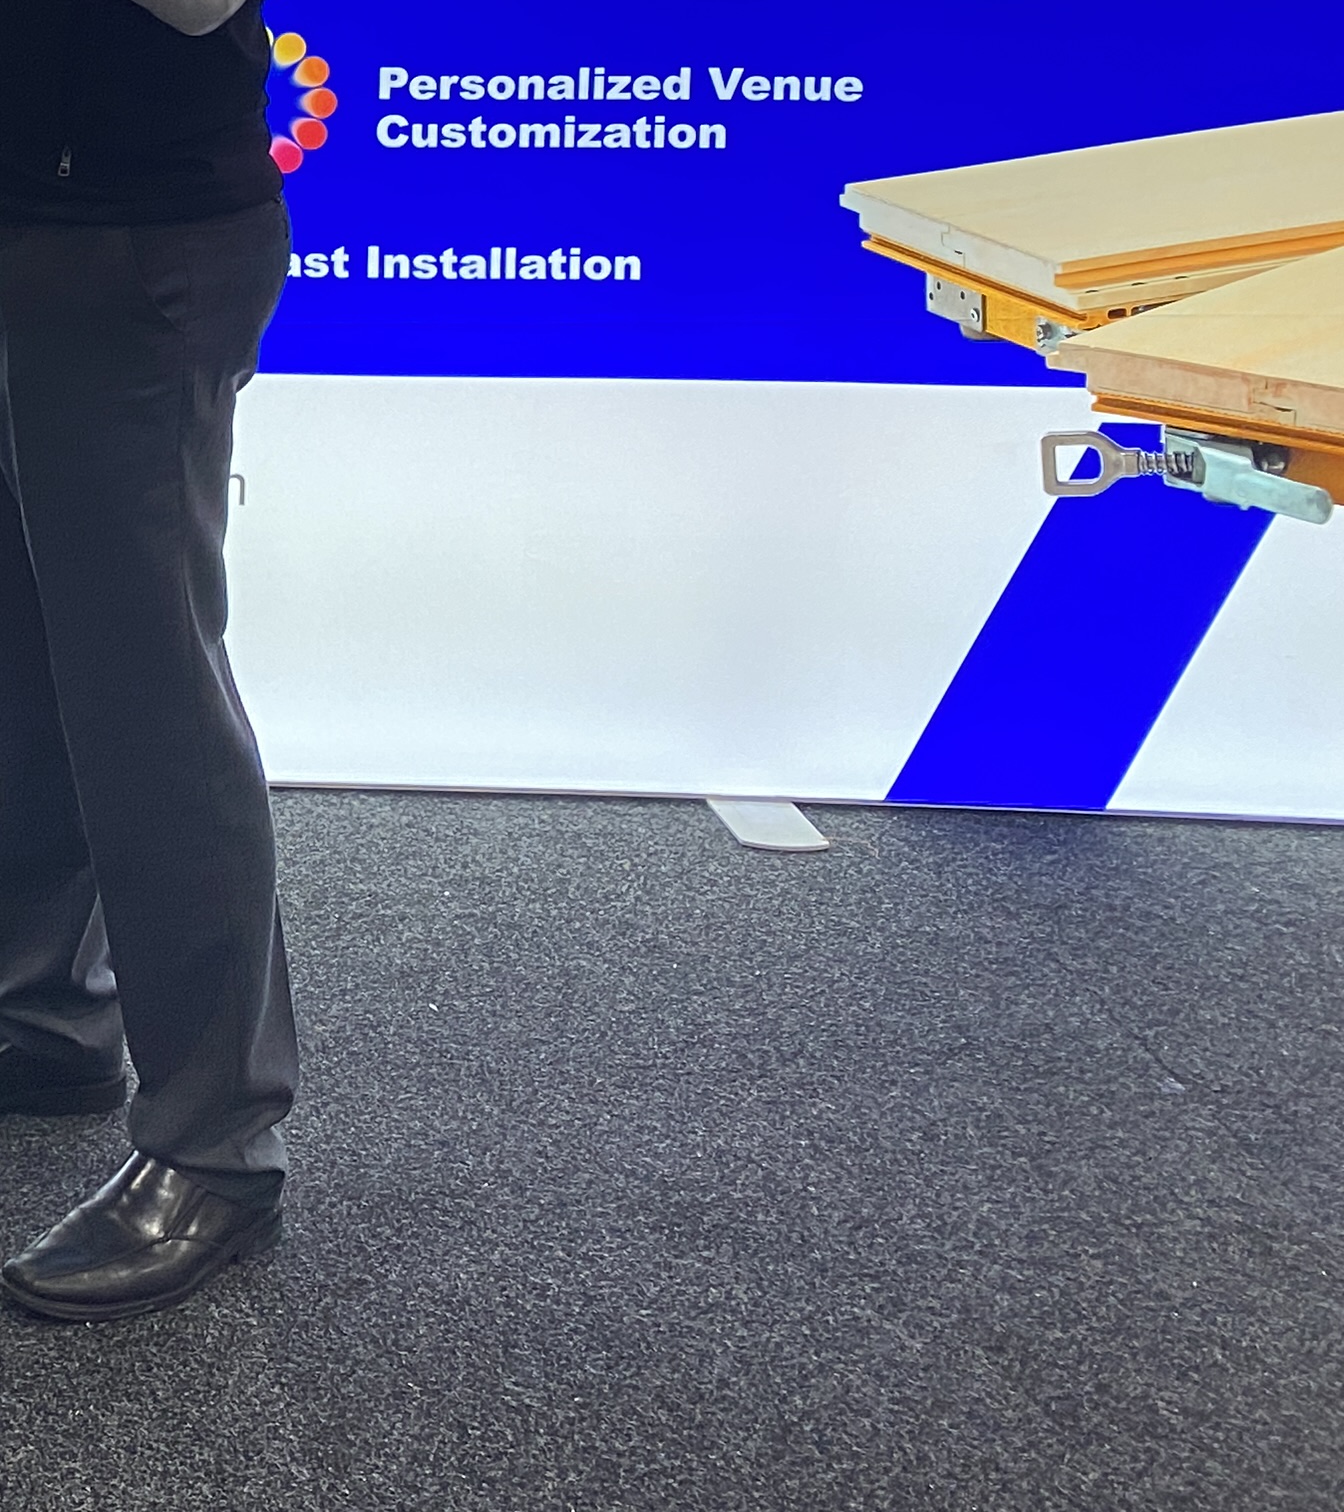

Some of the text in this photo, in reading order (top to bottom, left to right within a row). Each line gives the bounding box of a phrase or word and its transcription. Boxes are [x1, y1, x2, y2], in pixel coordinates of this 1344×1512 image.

[378, 67, 864, 102] Personalized Venue
[376, 114, 727, 149] Customization
[286, 245, 641, 281] ast Installation
